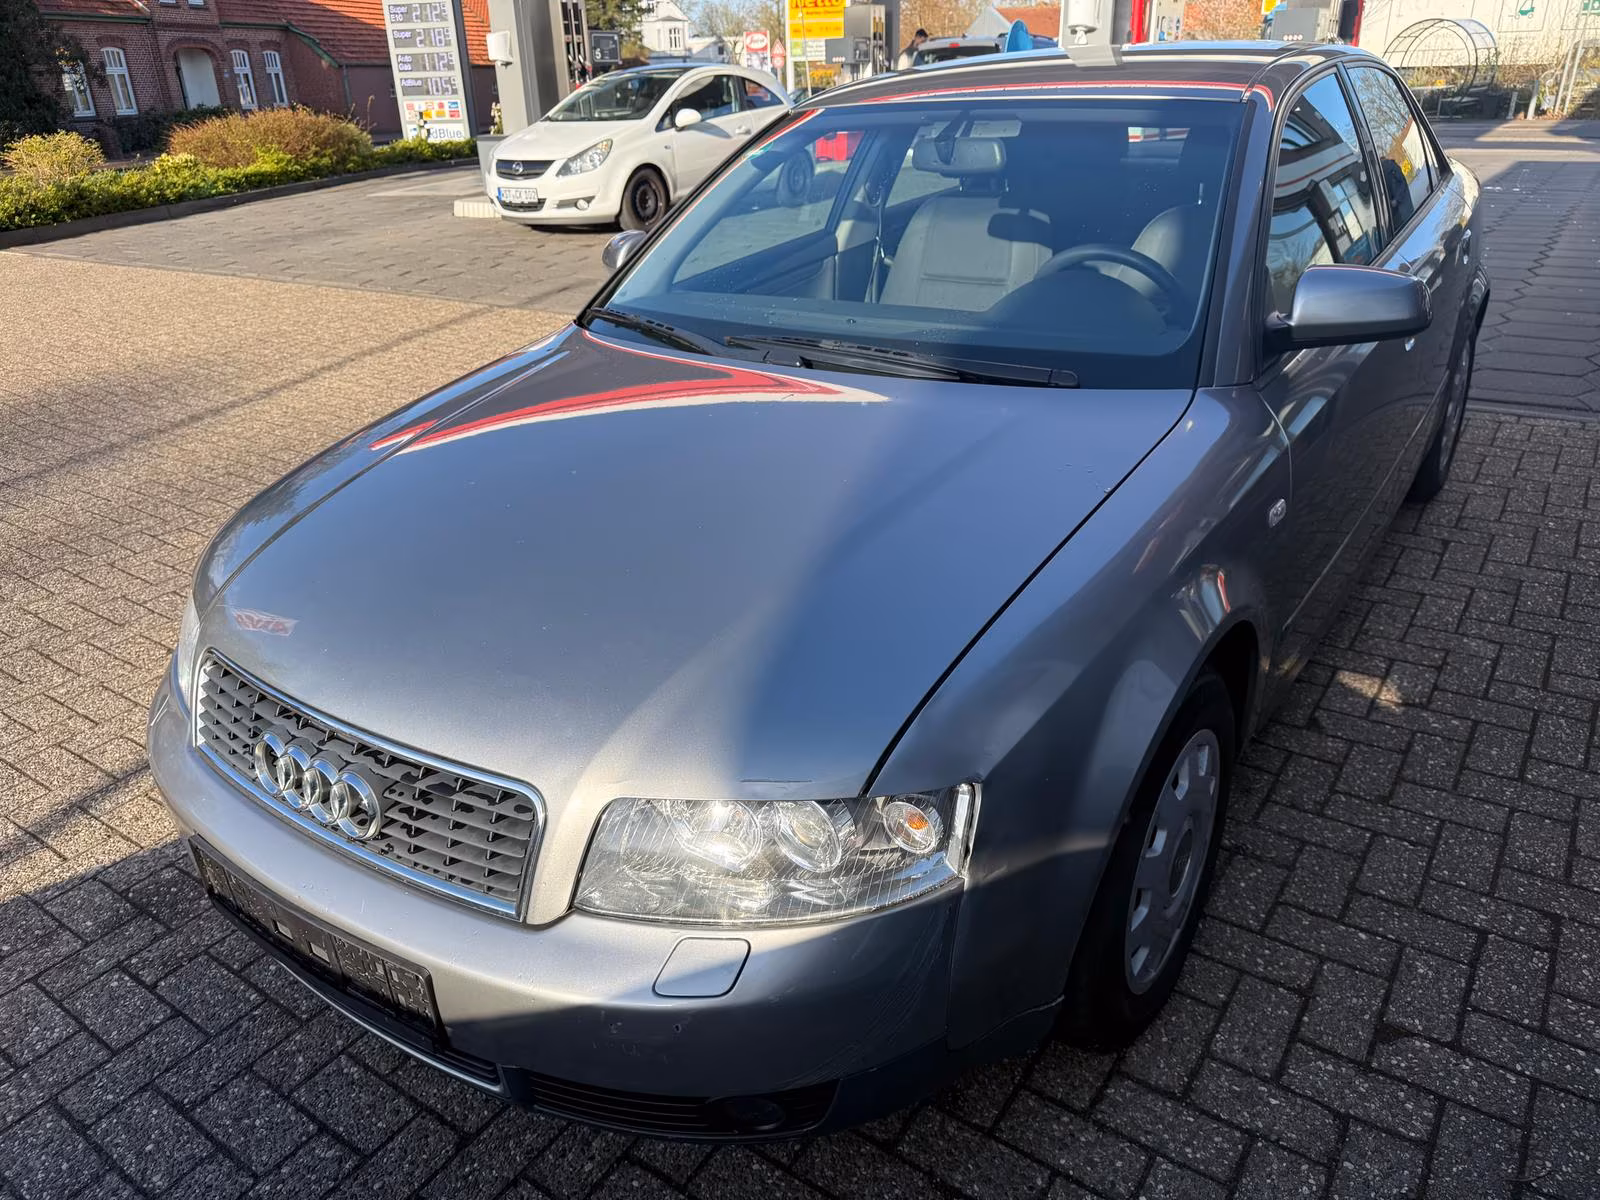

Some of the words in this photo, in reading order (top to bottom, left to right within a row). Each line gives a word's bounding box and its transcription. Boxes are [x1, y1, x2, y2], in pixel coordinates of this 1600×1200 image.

[390, 5, 408, 14] Super
[391, 14, 403, 22] E10
[393, 31, 412, 39] Super
[398, 55, 412, 63] Auto
[399, 63, 412, 71] Gas
[401, 79, 422, 87] AdBlue
[430, 128, 462, 138] dBlue
